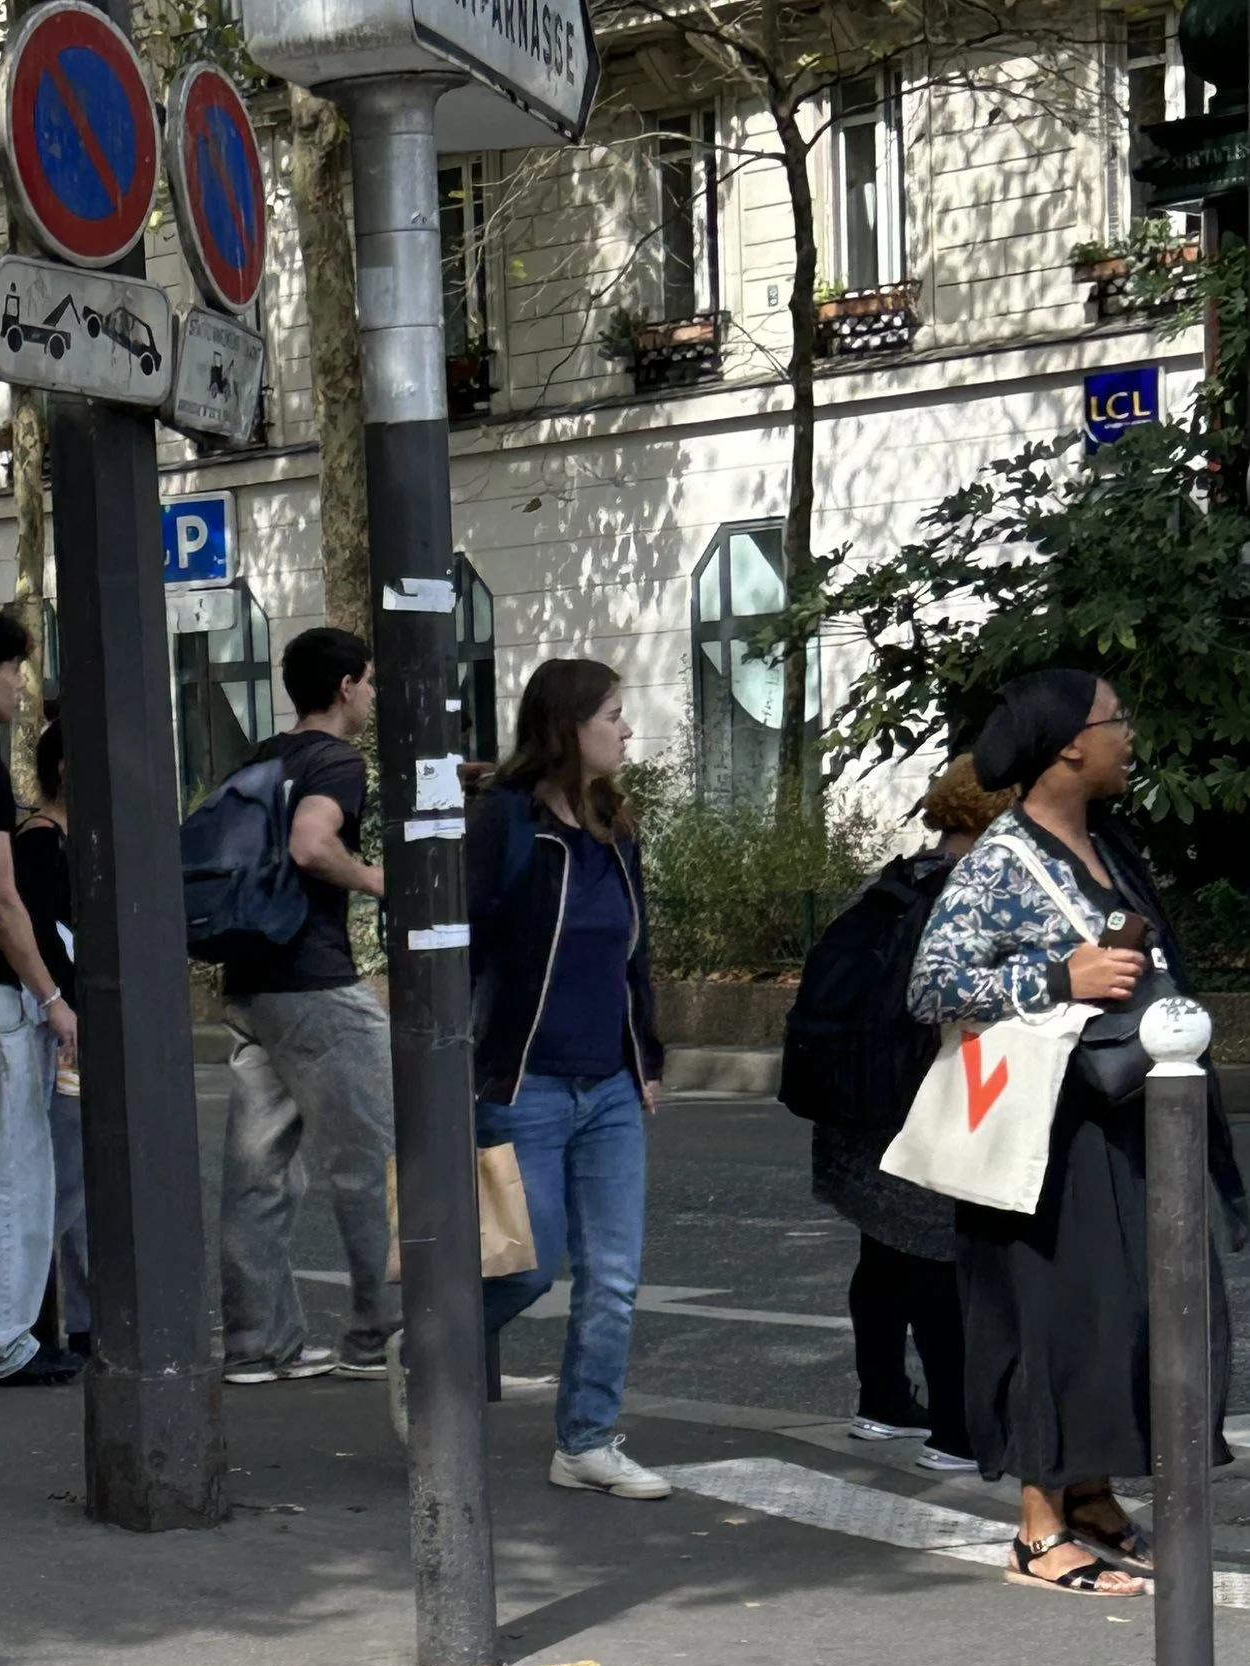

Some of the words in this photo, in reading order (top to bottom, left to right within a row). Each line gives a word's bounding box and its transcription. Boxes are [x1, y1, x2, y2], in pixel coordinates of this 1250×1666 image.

[454, 0, 575, 86] ARNASSE
[1091, 391, 1151, 422] LCL
[176, 515, 209, 569] P
